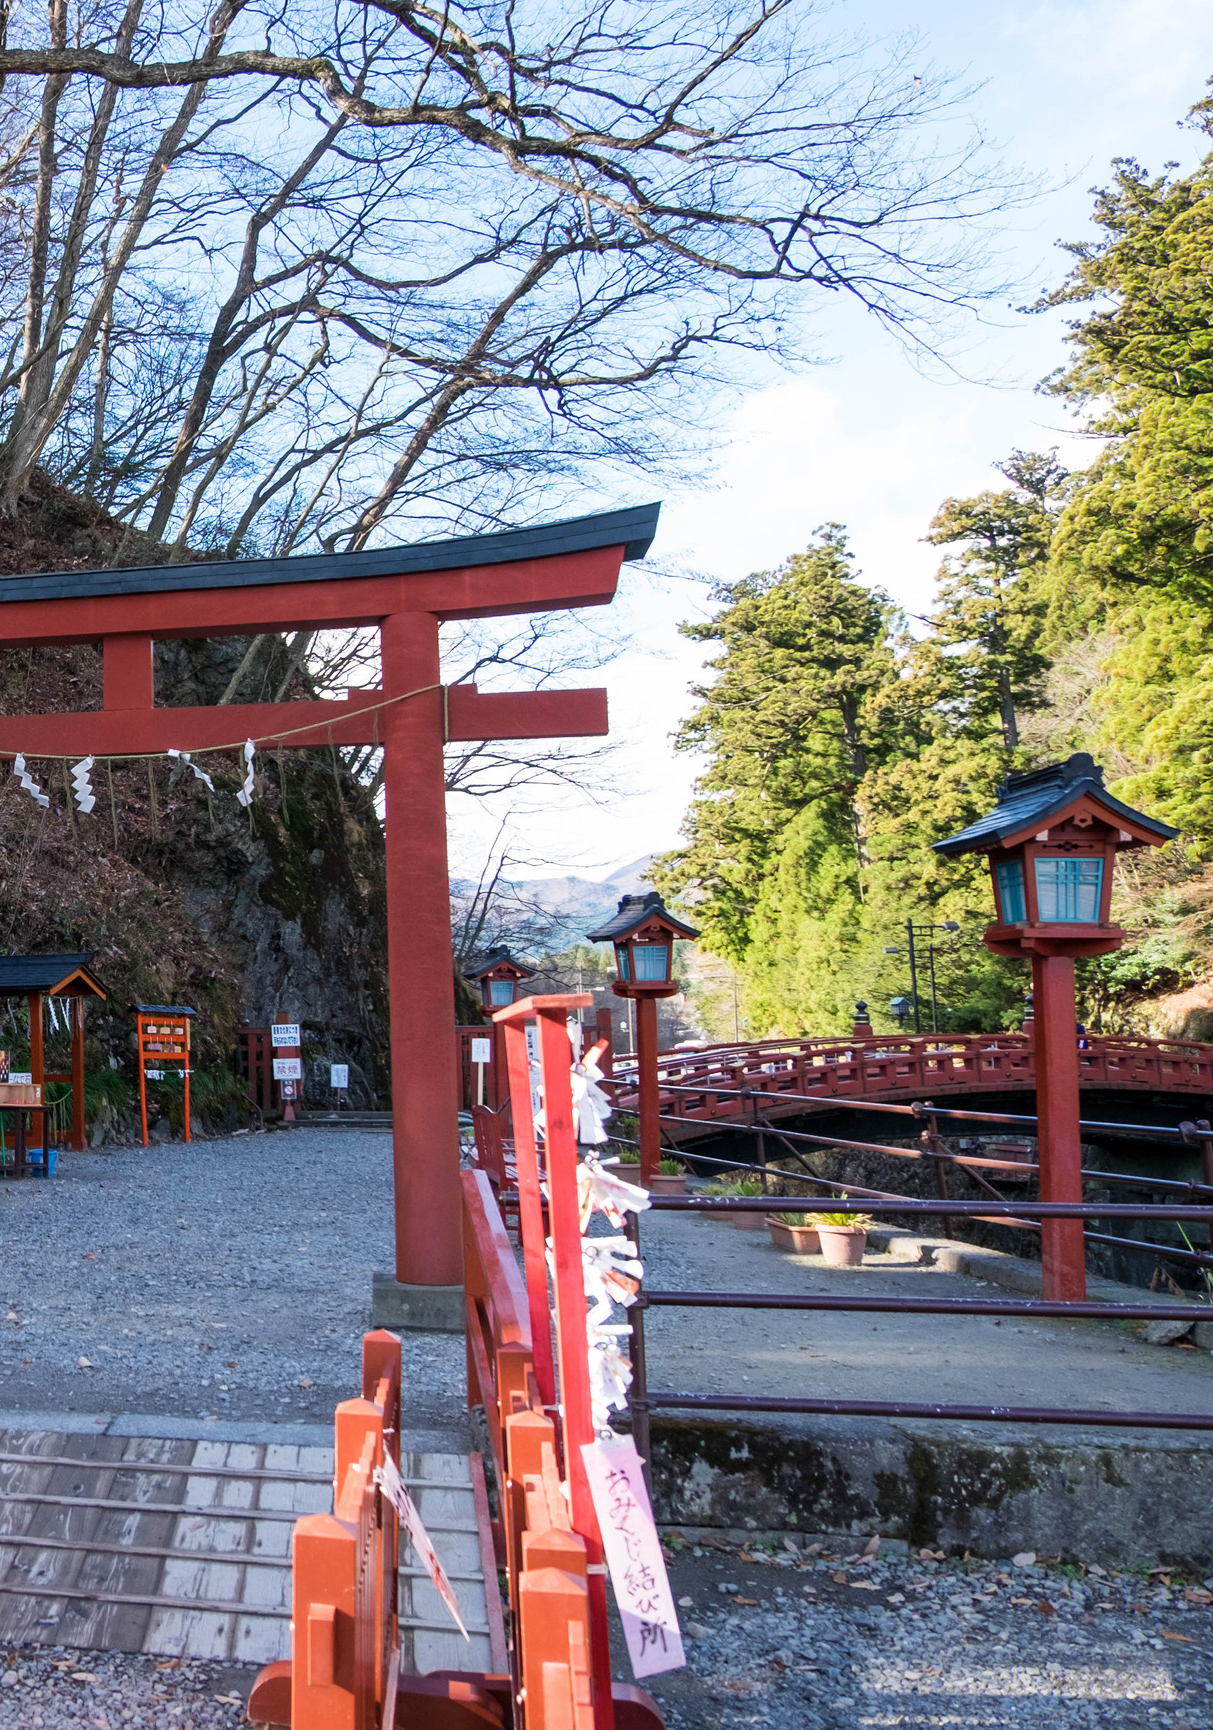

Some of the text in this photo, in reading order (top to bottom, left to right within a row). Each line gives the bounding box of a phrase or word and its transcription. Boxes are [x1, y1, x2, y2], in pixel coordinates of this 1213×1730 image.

[605, 1469, 668, 1658] おみくじ結び所
